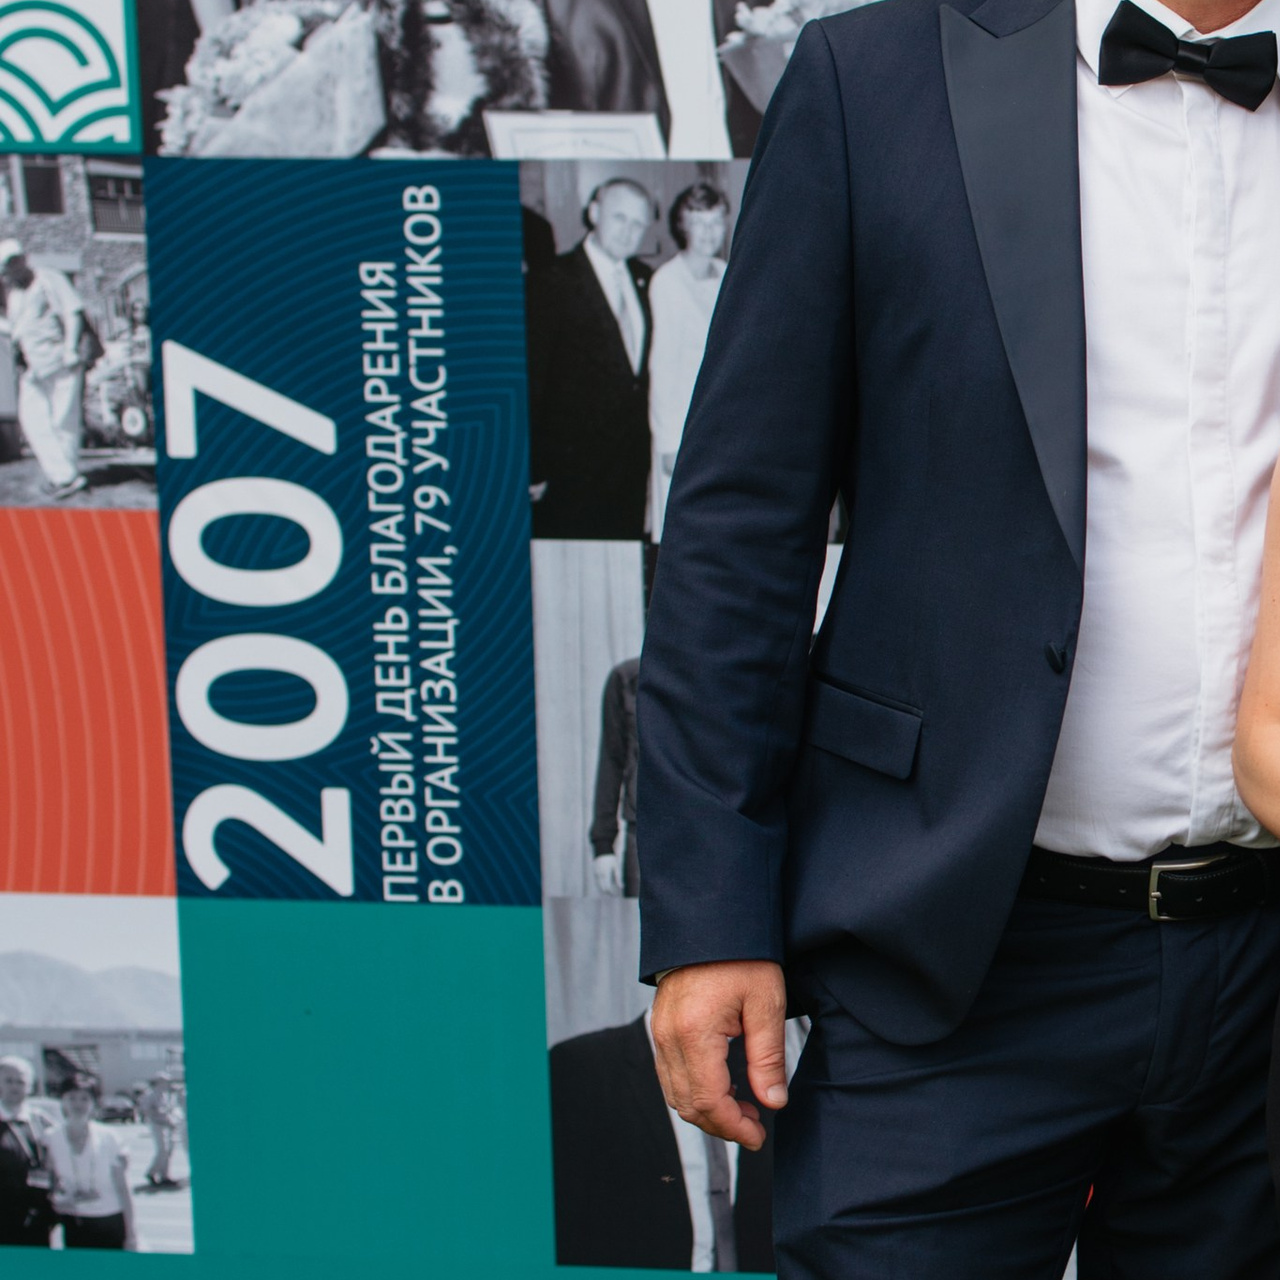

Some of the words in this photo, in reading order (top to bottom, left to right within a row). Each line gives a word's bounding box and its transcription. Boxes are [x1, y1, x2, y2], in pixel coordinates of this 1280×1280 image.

[359, 262, 411, 594] БЛАГОДАРЕНИЯ
[403, 185, 449, 472] УЧАСТНИКОВ
[162, 340, 354, 896] 2007
[414, 486, 450, 534] 79
[373, 607, 417, 721] ДЕНЬ
[416, 545, 464, 866] ОРГАНИЗАЦИИ,
[370, 733, 418, 901] ПЕРВЫЙ
[428, 880, 463, 902] В
